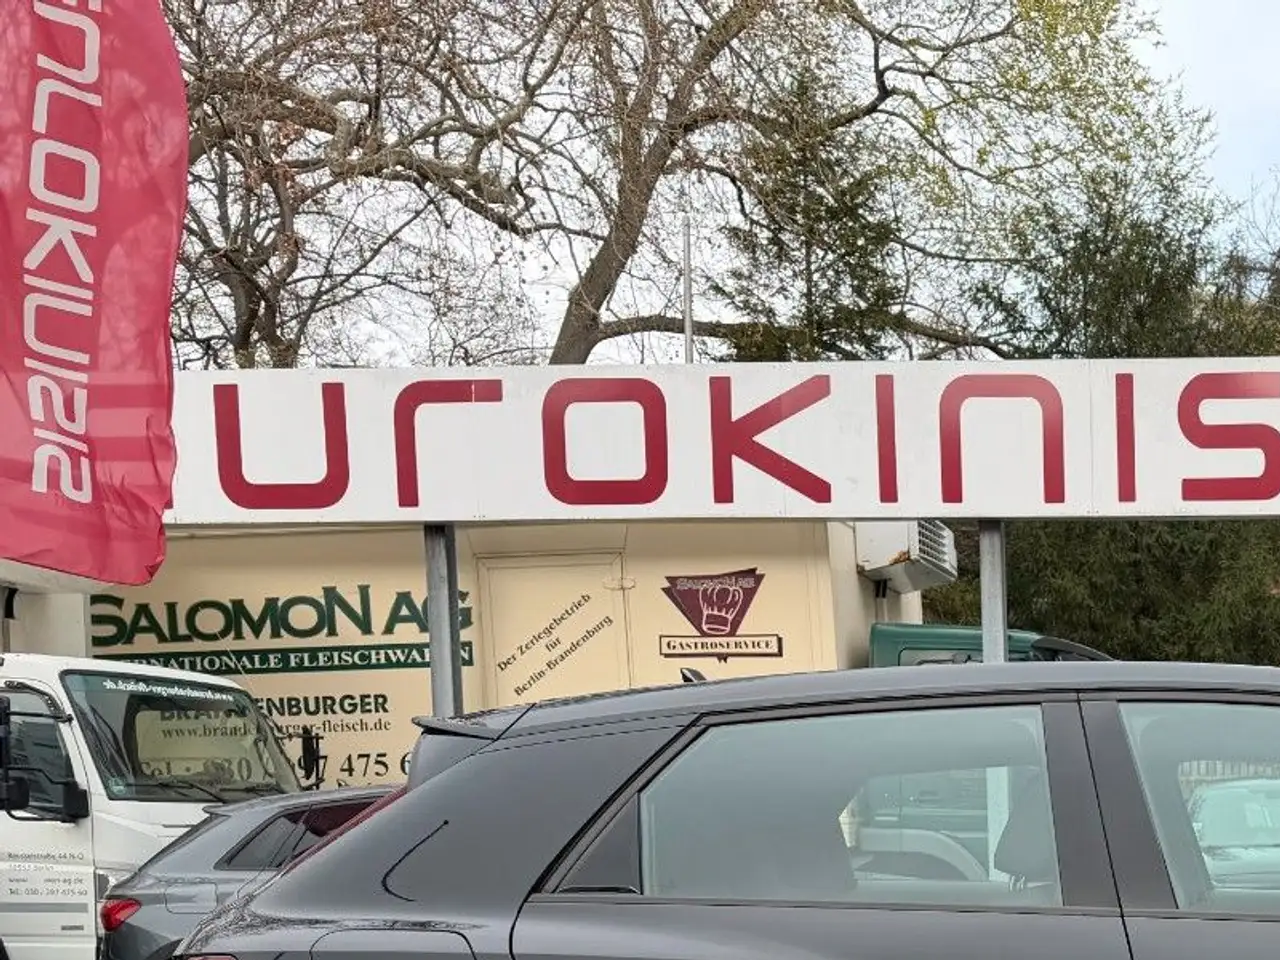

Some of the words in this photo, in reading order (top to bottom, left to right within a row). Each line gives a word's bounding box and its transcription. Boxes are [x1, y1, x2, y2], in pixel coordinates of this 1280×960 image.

[89, 584, 375, 647] SALOMON
[497, 653, 518, 672] Der
[517, 593, 592, 656] Zerlegebetrieb
[513, 615, 614, 696] Berlin-Brandenburg
[340, 753, 390, 777] 475
